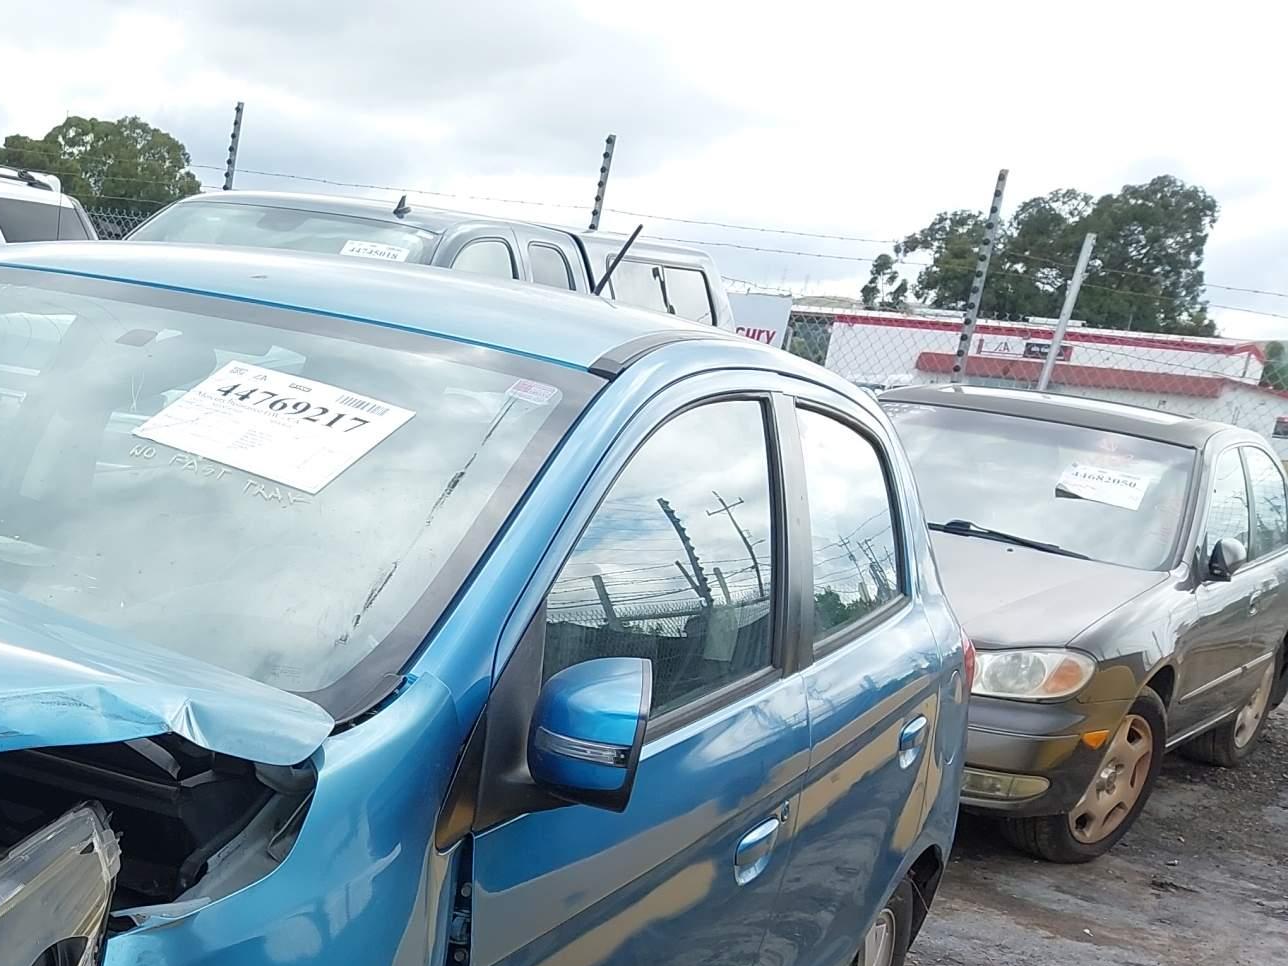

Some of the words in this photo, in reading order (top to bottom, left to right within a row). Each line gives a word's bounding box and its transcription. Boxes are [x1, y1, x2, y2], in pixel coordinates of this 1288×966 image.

[216, 383, 371, 433] 44769217
[129, 444, 157, 460] NO
[168, 452, 233, 481] FAST
